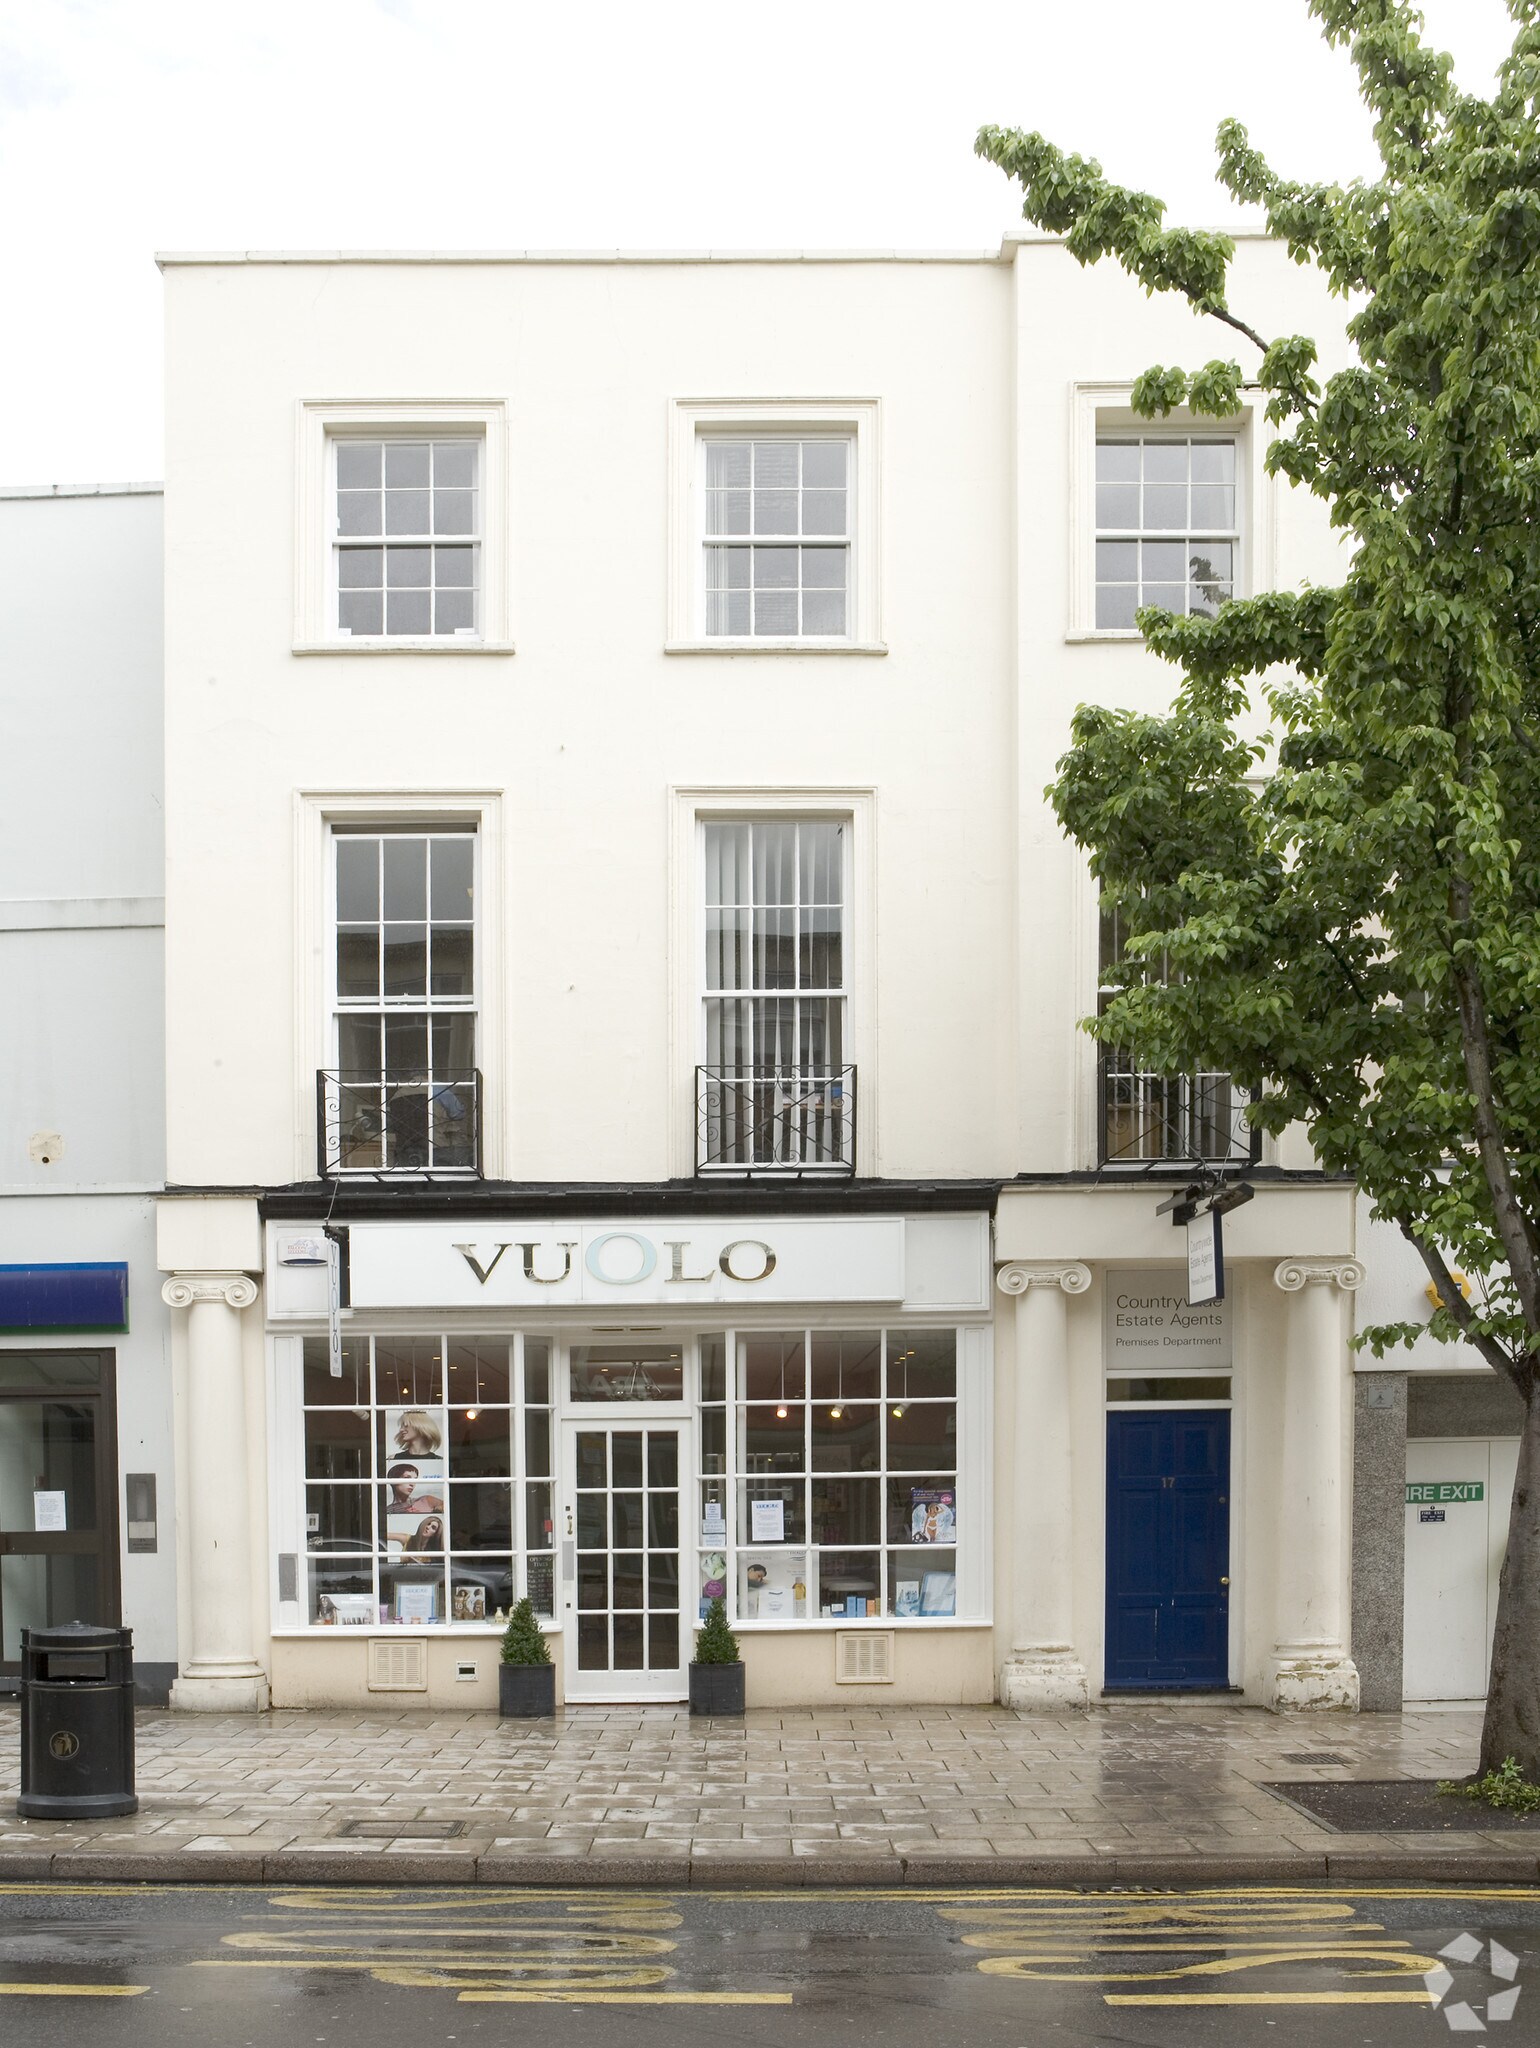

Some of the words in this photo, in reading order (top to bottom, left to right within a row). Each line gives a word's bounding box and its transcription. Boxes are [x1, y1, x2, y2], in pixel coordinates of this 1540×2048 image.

[452, 1232, 777, 1286] VUOLO
[330, 1244, 339, 1353] VUOLO
[1116, 1294, 1223, 1311] Countrye
[1116, 1313, 1164, 1327] Estate
[1170, 1312, 1223, 1329] Agents
[1115, 1337, 1159, 1347] Premises
[1163, 1336, 1222, 1347] Department
[1161, 1476, 1176, 1489] 17
[1405, 1486, 1435, 1501] IRE
[1439, 1484, 1480, 1500] EXIT
[937, 1903, 1445, 1982] BUS
